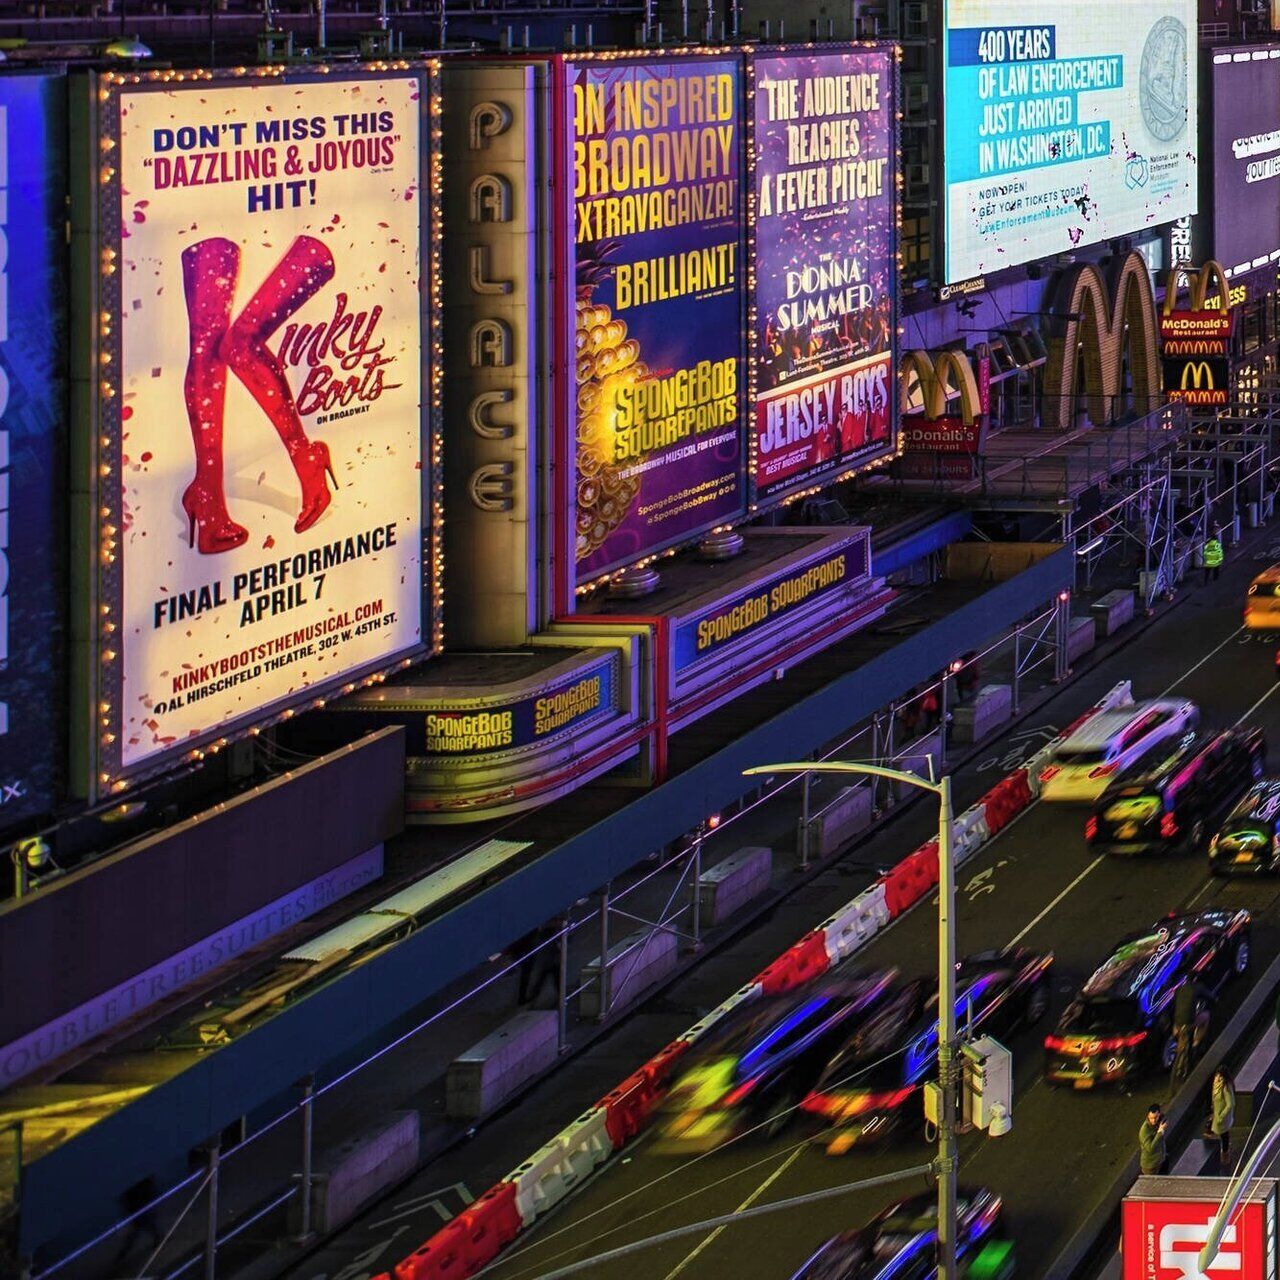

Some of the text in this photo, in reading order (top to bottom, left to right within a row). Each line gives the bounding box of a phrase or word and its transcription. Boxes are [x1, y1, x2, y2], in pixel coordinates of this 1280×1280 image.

[978, 29, 1050, 63] 400 YEARS
[614, 73, 735, 132] INSPIRED
[978, 59, 1119, 99] OF LAW ENFORCEMENT
[153, 111, 394, 153] DON'T MISS THIS
[979, 96, 1072, 136] JUST ARRIVED
[573, 124, 735, 198] BROADWAY
[979, 141, 995, 173] IN
[1087, 125, 1106, 154] DC.
[248, 179, 316, 213] HIT!
[786, 257, 861, 300] DONNA
[468, 100, 516, 513] PALACE
[777, 284, 873, 332] SUMMER
[811, 321, 840, 334] MUSICAL
[1162, 319, 1229, 330] McDonald's
[297, 360, 403, 417] Boots
[760, 379, 837, 454] JERSEY
[841, 364, 889, 414] BOYS
[153, 522, 397, 629] FINAL PERFORMANCE
[239, 573, 326, 628] APRIL 7
[697, 553, 846, 653] SPONGEBOB SQUAREPANTS
[172, 599, 383, 694] KINKYBOOTSTHEMUSICAL.COM
[426, 730, 513, 752] SQUAREPANTS
